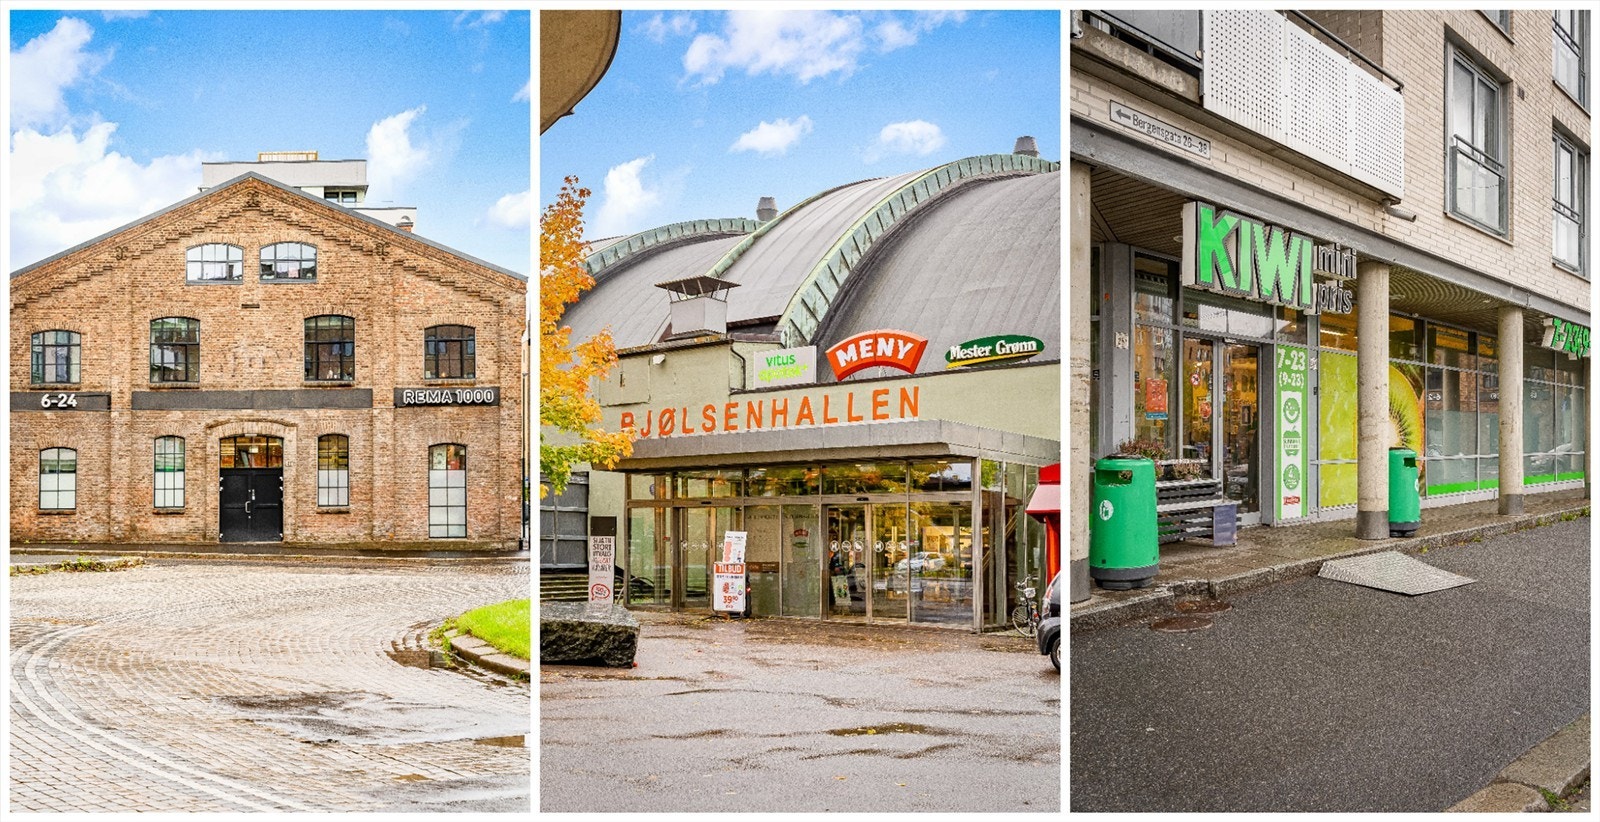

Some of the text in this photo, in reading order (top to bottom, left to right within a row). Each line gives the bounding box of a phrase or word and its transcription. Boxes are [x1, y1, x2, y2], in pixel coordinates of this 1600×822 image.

[1132, 113, 1181, 142] Bergensgata
[1198, 202, 1313, 309] KIWI
[1318, 242, 1357, 279] mini
[1317, 279, 1353, 315] pris
[765, 354, 796, 367] vitus
[835, 337, 914, 368] MENY
[950, 339, 1037, 360] Mester Grønn
[1277, 348, 1306, 371] 7-23
[1278, 371, 1305, 389] (9-23)
[41, 393, 78, 408] 6-24
[403, 389, 494, 404] REMA 1000
[620, 386, 920, 438] BJØLSENHALLEN
[719, 564, 742, 573] TILBUD
